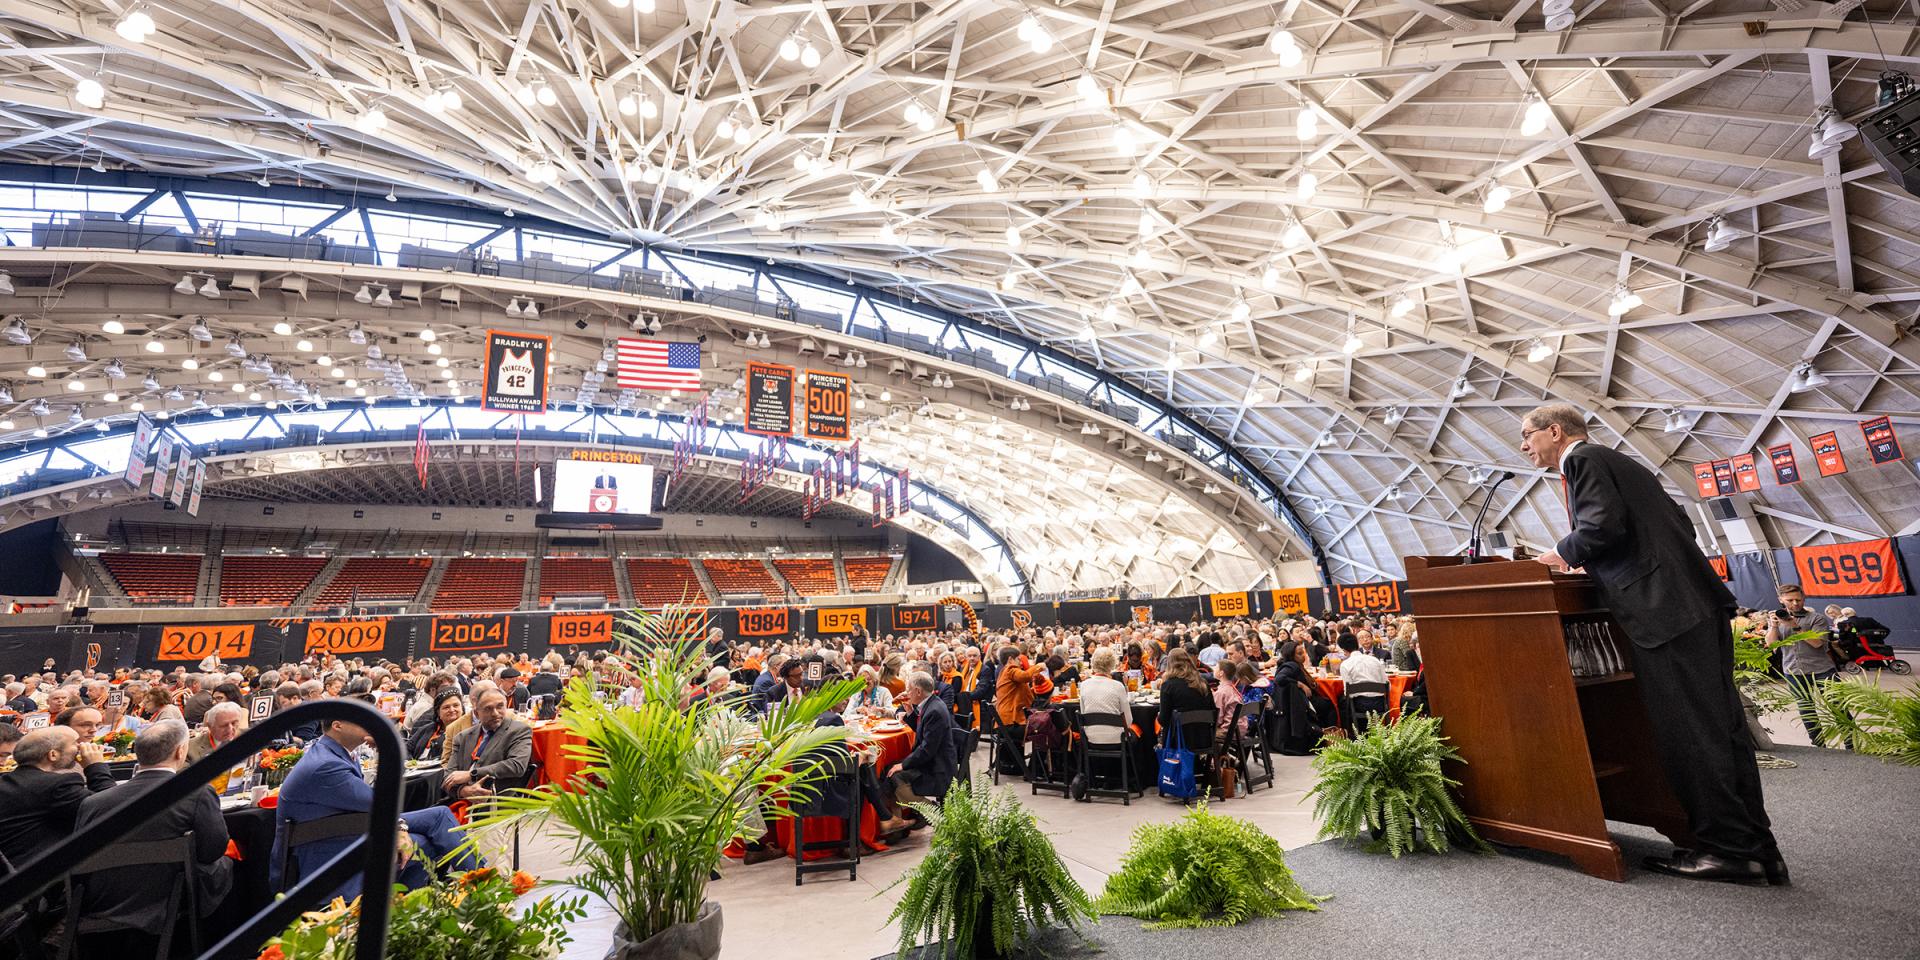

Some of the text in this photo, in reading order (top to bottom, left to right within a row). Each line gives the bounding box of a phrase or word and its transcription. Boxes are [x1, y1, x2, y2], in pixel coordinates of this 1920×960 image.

[495, 338, 530, 348] BRADLEY
[502, 365, 532, 374] PRINCETON
[768, 369, 790, 377] CARRIL
[507, 375, 525, 388] 42
[809, 373, 846, 384] PRINCETON
[488, 396, 518, 404] SULLIVAN
[810, 387, 845, 416] 500
[810, 413, 845, 422] CHAMPIONSHIPS
[821, 423, 836, 435] Ivy
[572, 450, 641, 464] PRINCETON
[1807, 552, 1883, 585] 1999
[1279, 594, 1301, 609] 1964
[1342, 585, 1392, 608] 1959
[1215, 597, 1244, 611] 1969
[740, 613, 786, 632] 1984
[824, 615, 860, 627] 1979
[899, 610, 931, 624] 1974
[439, 622, 501, 644] 2004
[558, 620, 605, 638] 1994
[165, 629, 246, 655] 2014
[309, 625, 381, 649] 2009
[812, 666, 819, 676] 5
[257, 701, 267, 714] 6
[32, 718, 46, 728] '67
